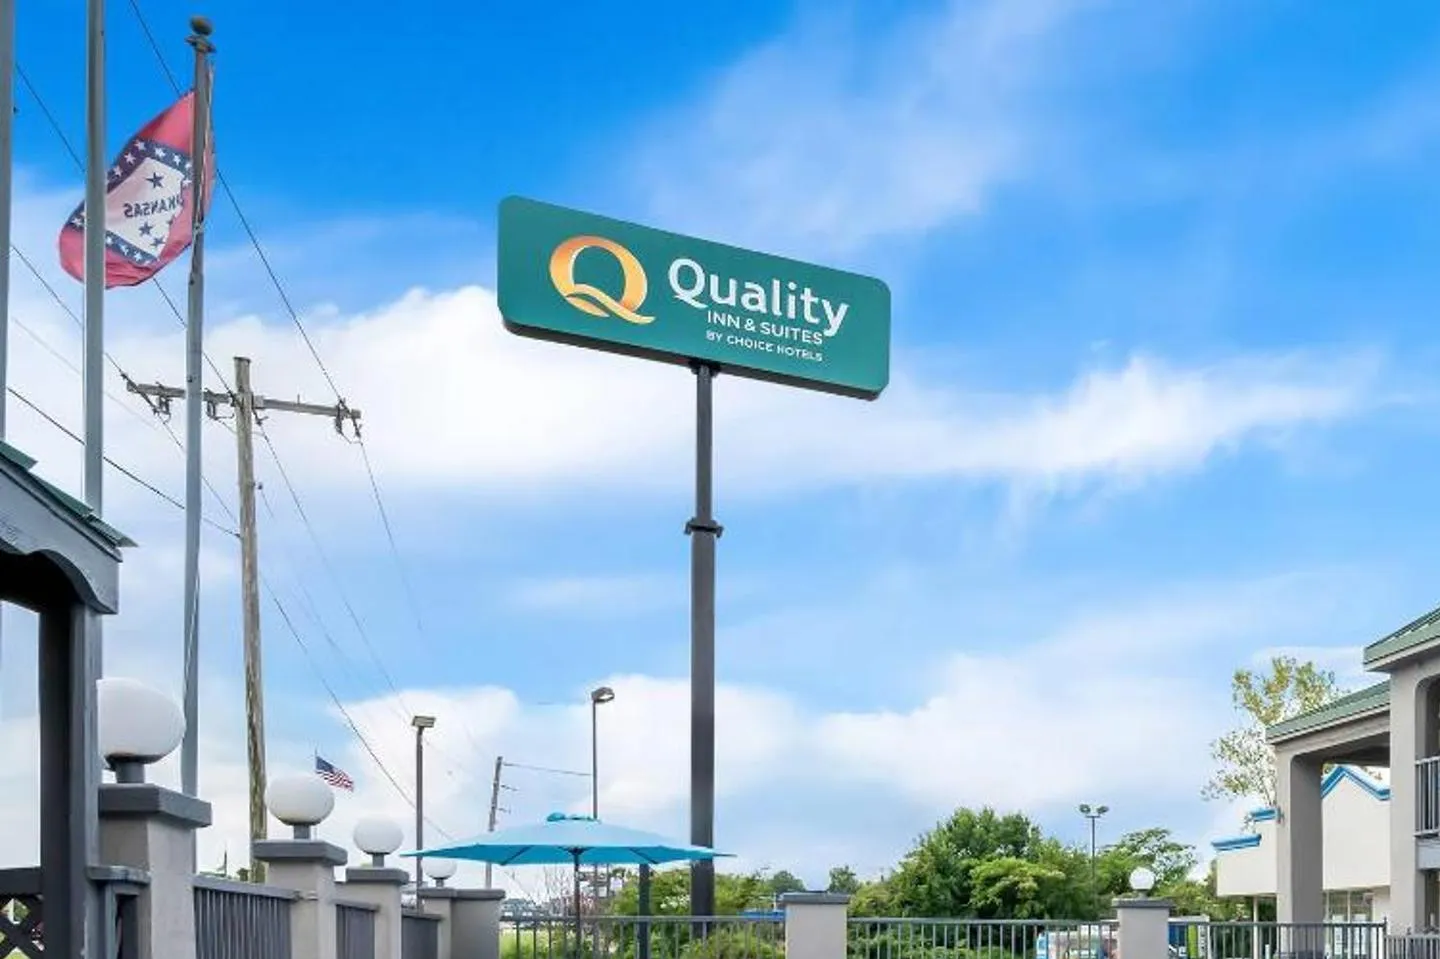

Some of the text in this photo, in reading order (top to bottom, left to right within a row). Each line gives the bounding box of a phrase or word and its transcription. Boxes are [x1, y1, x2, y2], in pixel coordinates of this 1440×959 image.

[668, 257, 849, 335] Quality
[707, 310, 823, 345] INN & SUITES
[706, 330, 823, 361] BY CHOICE HOTELS
